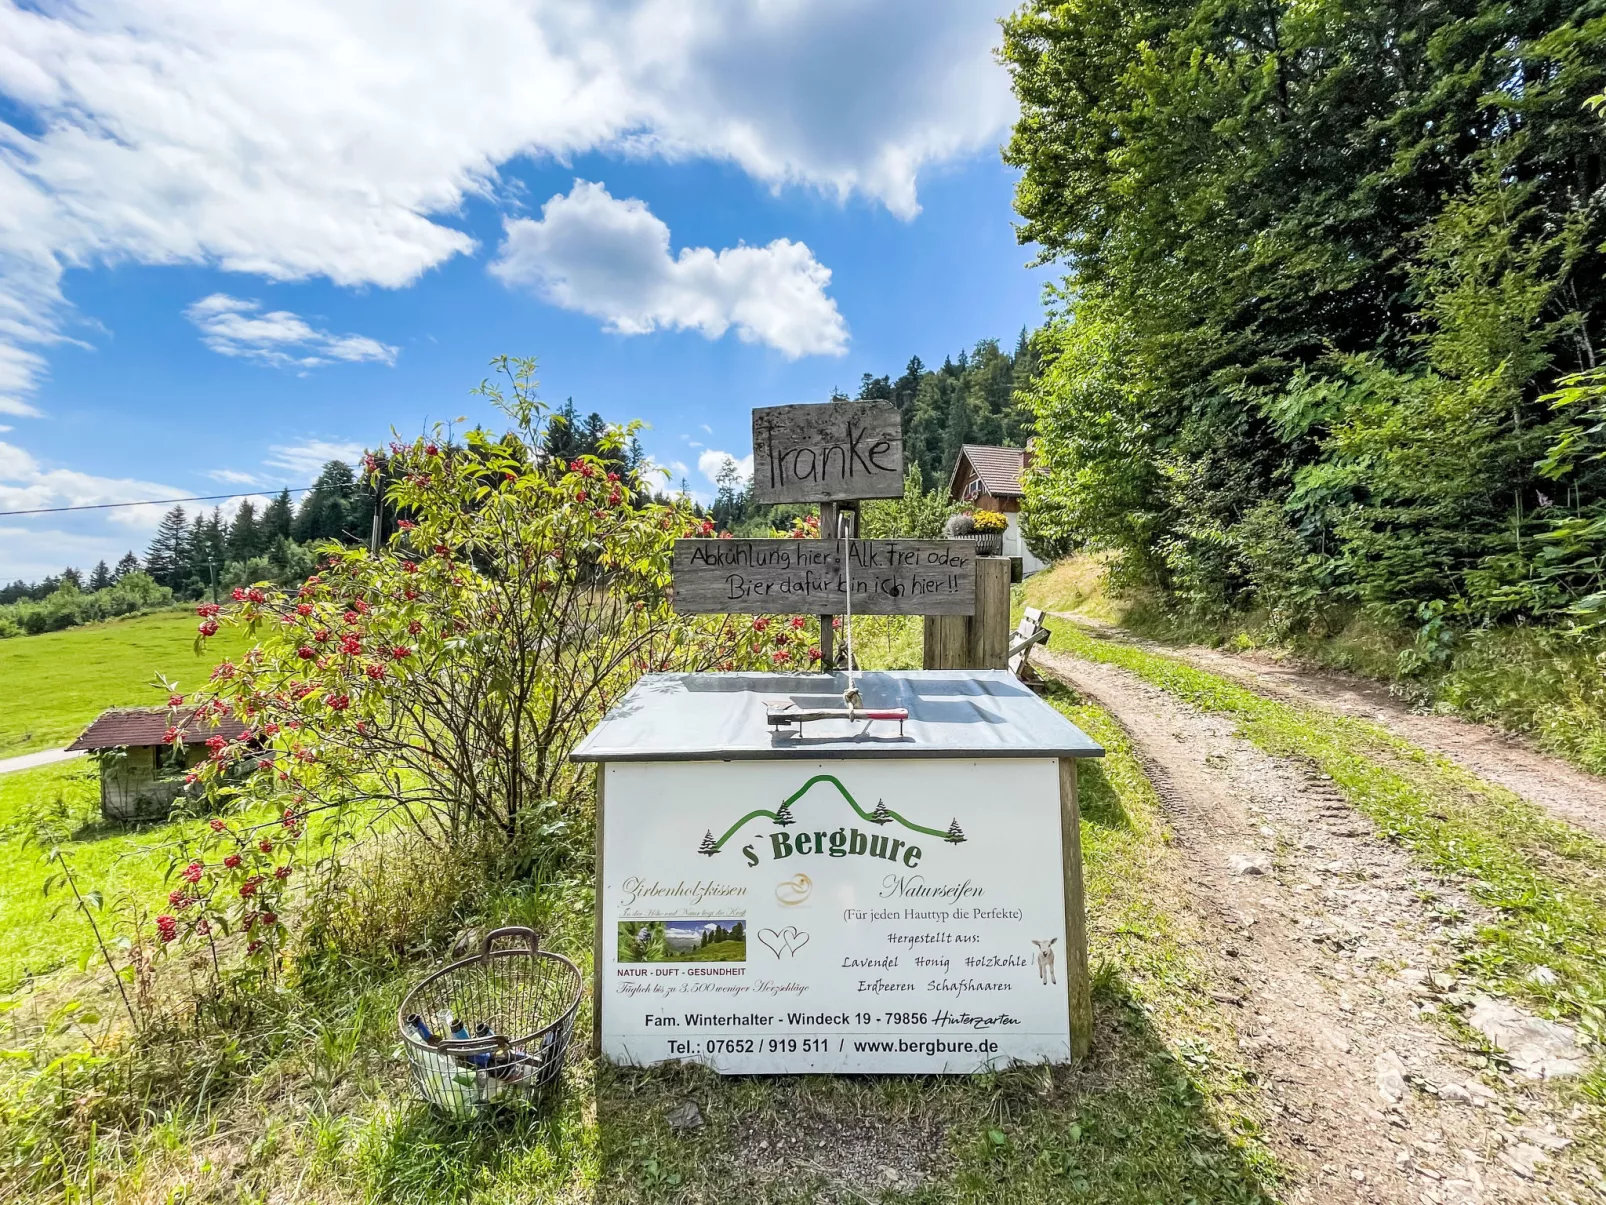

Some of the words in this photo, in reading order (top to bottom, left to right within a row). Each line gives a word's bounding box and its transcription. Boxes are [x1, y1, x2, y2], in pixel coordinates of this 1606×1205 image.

[690, 543, 791, 570] Abkühlung
[797, 541, 841, 567] hier!
[848, 541, 883, 568] Alk.
[927, 547, 969, 568] oder
[725, 573, 775, 600] Bier
[779, 570, 833, 596] dafür
[875, 574, 906, 597] ich
[769, 827, 922, 869] Bergbure
[620, 876, 748, 906] Zirbenholzkissen
[878, 874, 986, 905] Naturseifen
[843, 908, 867, 923] (Für
[869, 908, 900, 925] jeden
[904, 909, 950, 925] Hauttyp
[952, 908, 970, 921] die
[973, 907, 1024, 922] Perfekte)
[887, 932, 953, 951] Hergestellt
[955, 933, 980, 943] aus:
[617, 969, 648, 978] NATUR
[655, 969, 679, 978] DUFT
[687, 968, 746, 978] GESUNDHEIT
[841, 955, 900, 970] Lavendel
[914, 956, 950, 974] Honig
[965, 954, 1028, 968] Holzkohle
[652, 983, 665, 994] bis
[664, 987, 677, 998] zu
[715, 985, 750, 998] weniger
[857, 978, 915, 995] Erdbeeren
[926, 979, 1013, 999] Schafshaaren
[645, 1014, 680, 1027] Fam.
[685, 1013, 774, 1027] Winterhalter
[787, 1012, 850, 1026] Windeck
[855, 1012, 871, 1025] 19
[885, 1012, 928, 1025] 79856
[931, 1009, 1022, 1030] Hinterzarten
[667, 1039, 700, 1054] Tel.:
[706, 1039, 754, 1053] 07652
[768, 1039, 797, 1052] 919
[802, 1038, 828, 1052] 511
[853, 1038, 999, 1056] www.bergbure.de
